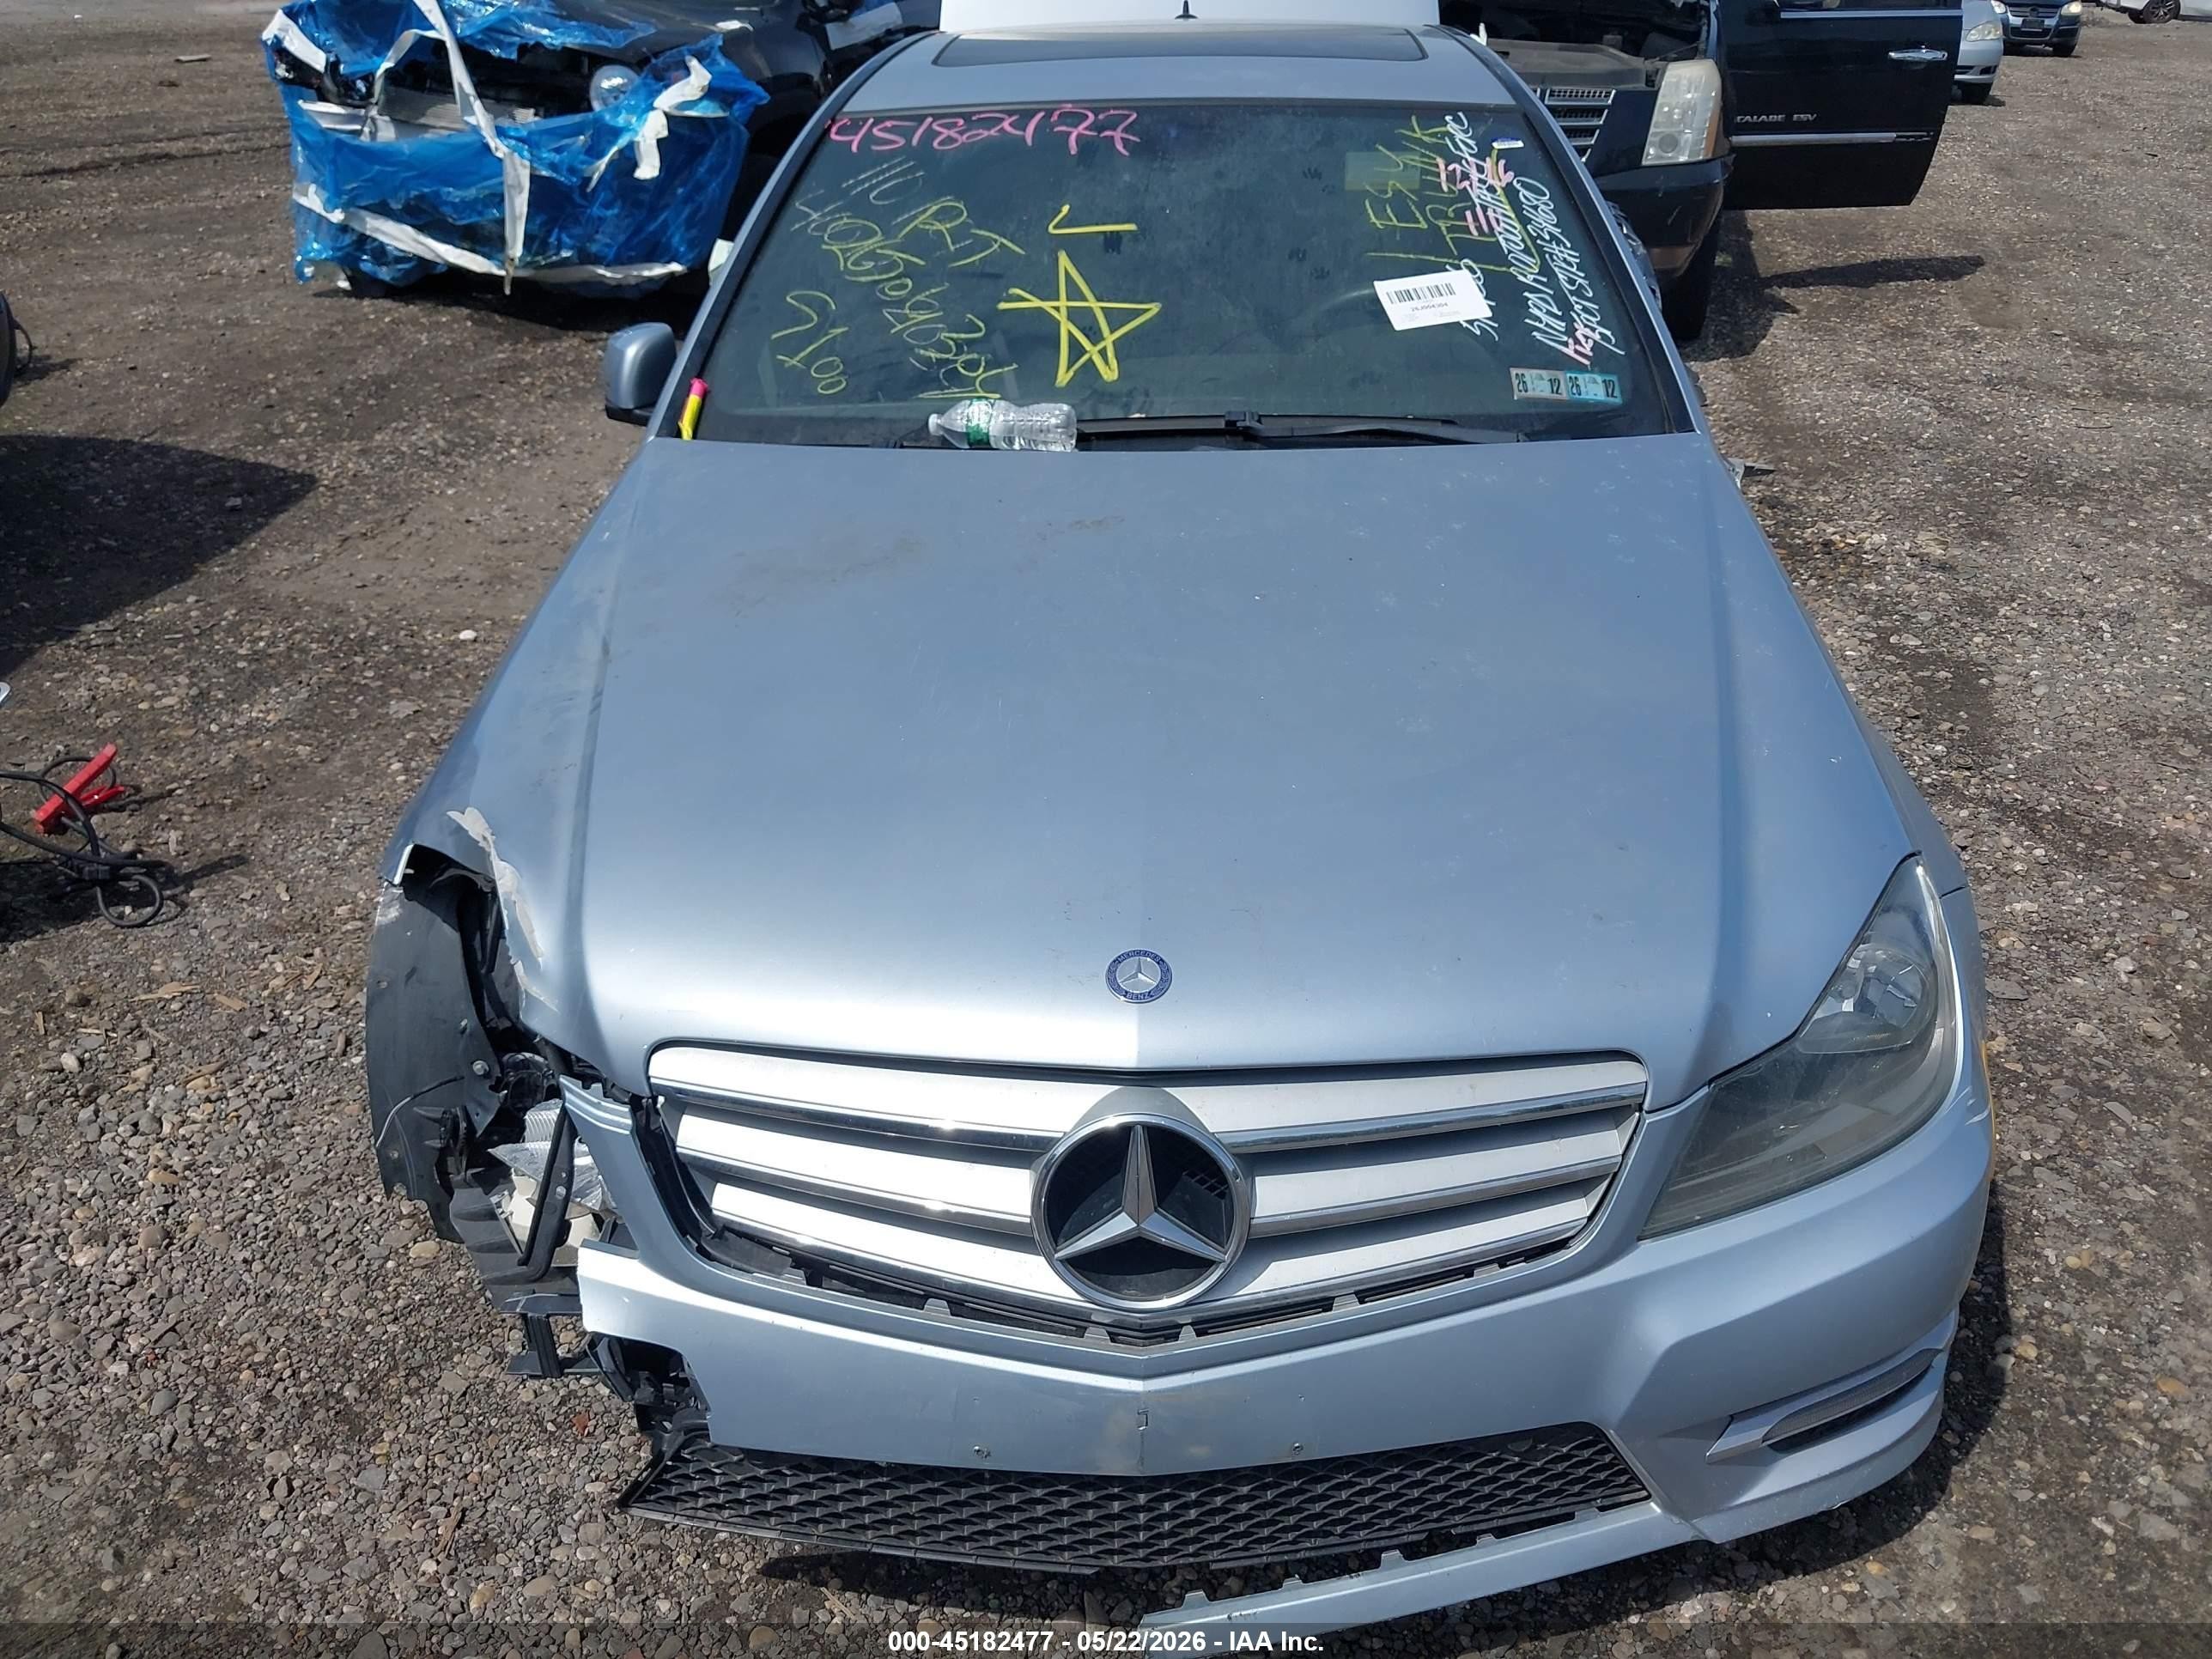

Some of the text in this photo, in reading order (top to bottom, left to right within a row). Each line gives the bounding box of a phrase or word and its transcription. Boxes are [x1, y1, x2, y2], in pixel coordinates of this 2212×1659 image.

[1792, 113, 1817, 122] ESV
[826, 105, 1140, 156] 45182477
[1515, 373, 1563, 395] 26 12
[1569, 375, 1618, 399] 26 12
[1118, 950, 1161, 963] MERCEDES
[1127, 992, 1152, 1000] BENZ
